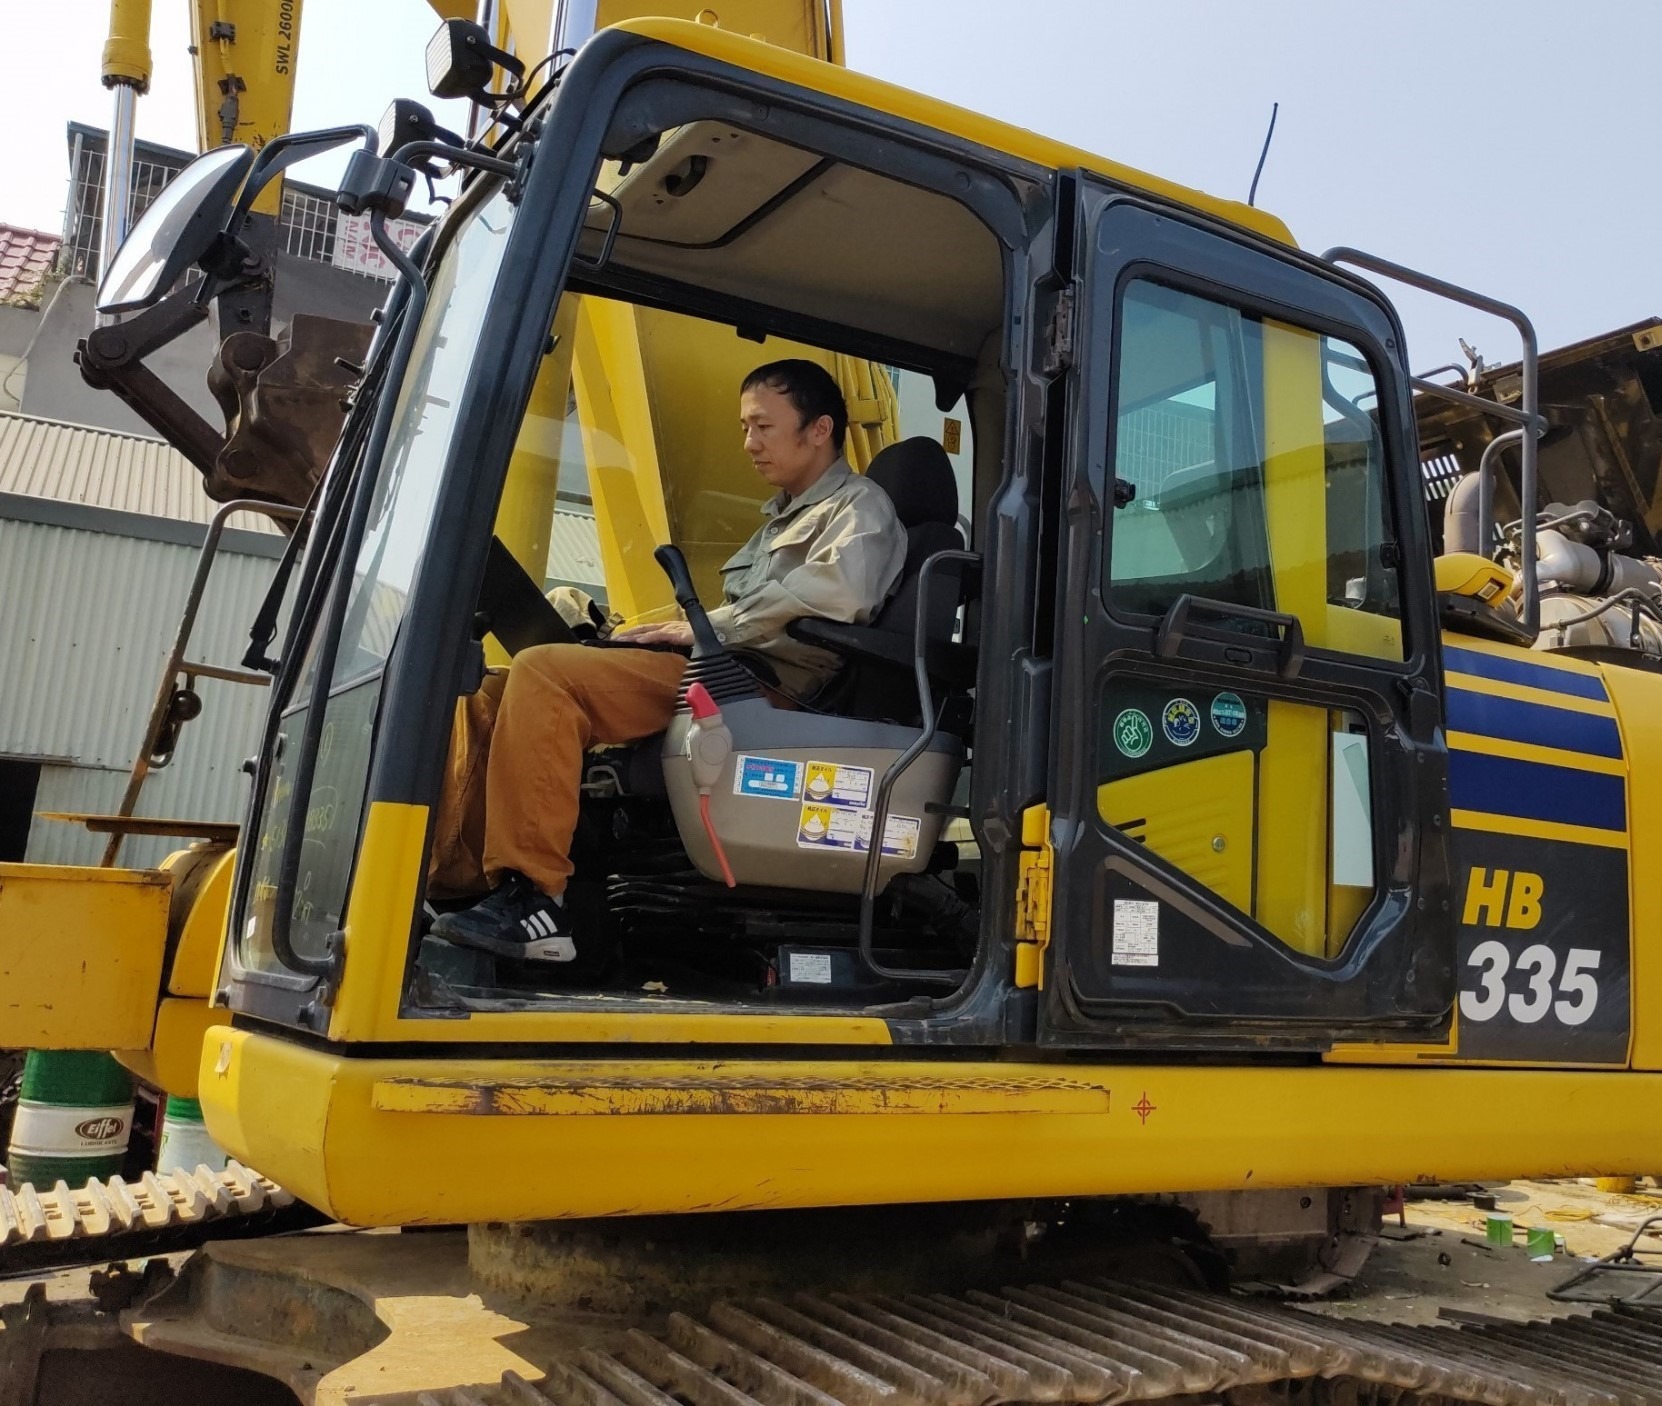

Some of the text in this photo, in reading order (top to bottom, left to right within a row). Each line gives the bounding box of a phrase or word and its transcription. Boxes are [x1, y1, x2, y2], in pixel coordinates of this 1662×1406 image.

[276, 0, 294, 75] SWL 2600
[1462, 866, 1545, 930] HB
[1459, 940, 1602, 1026] 335
[87, 1118, 118, 1139] Eiffel
